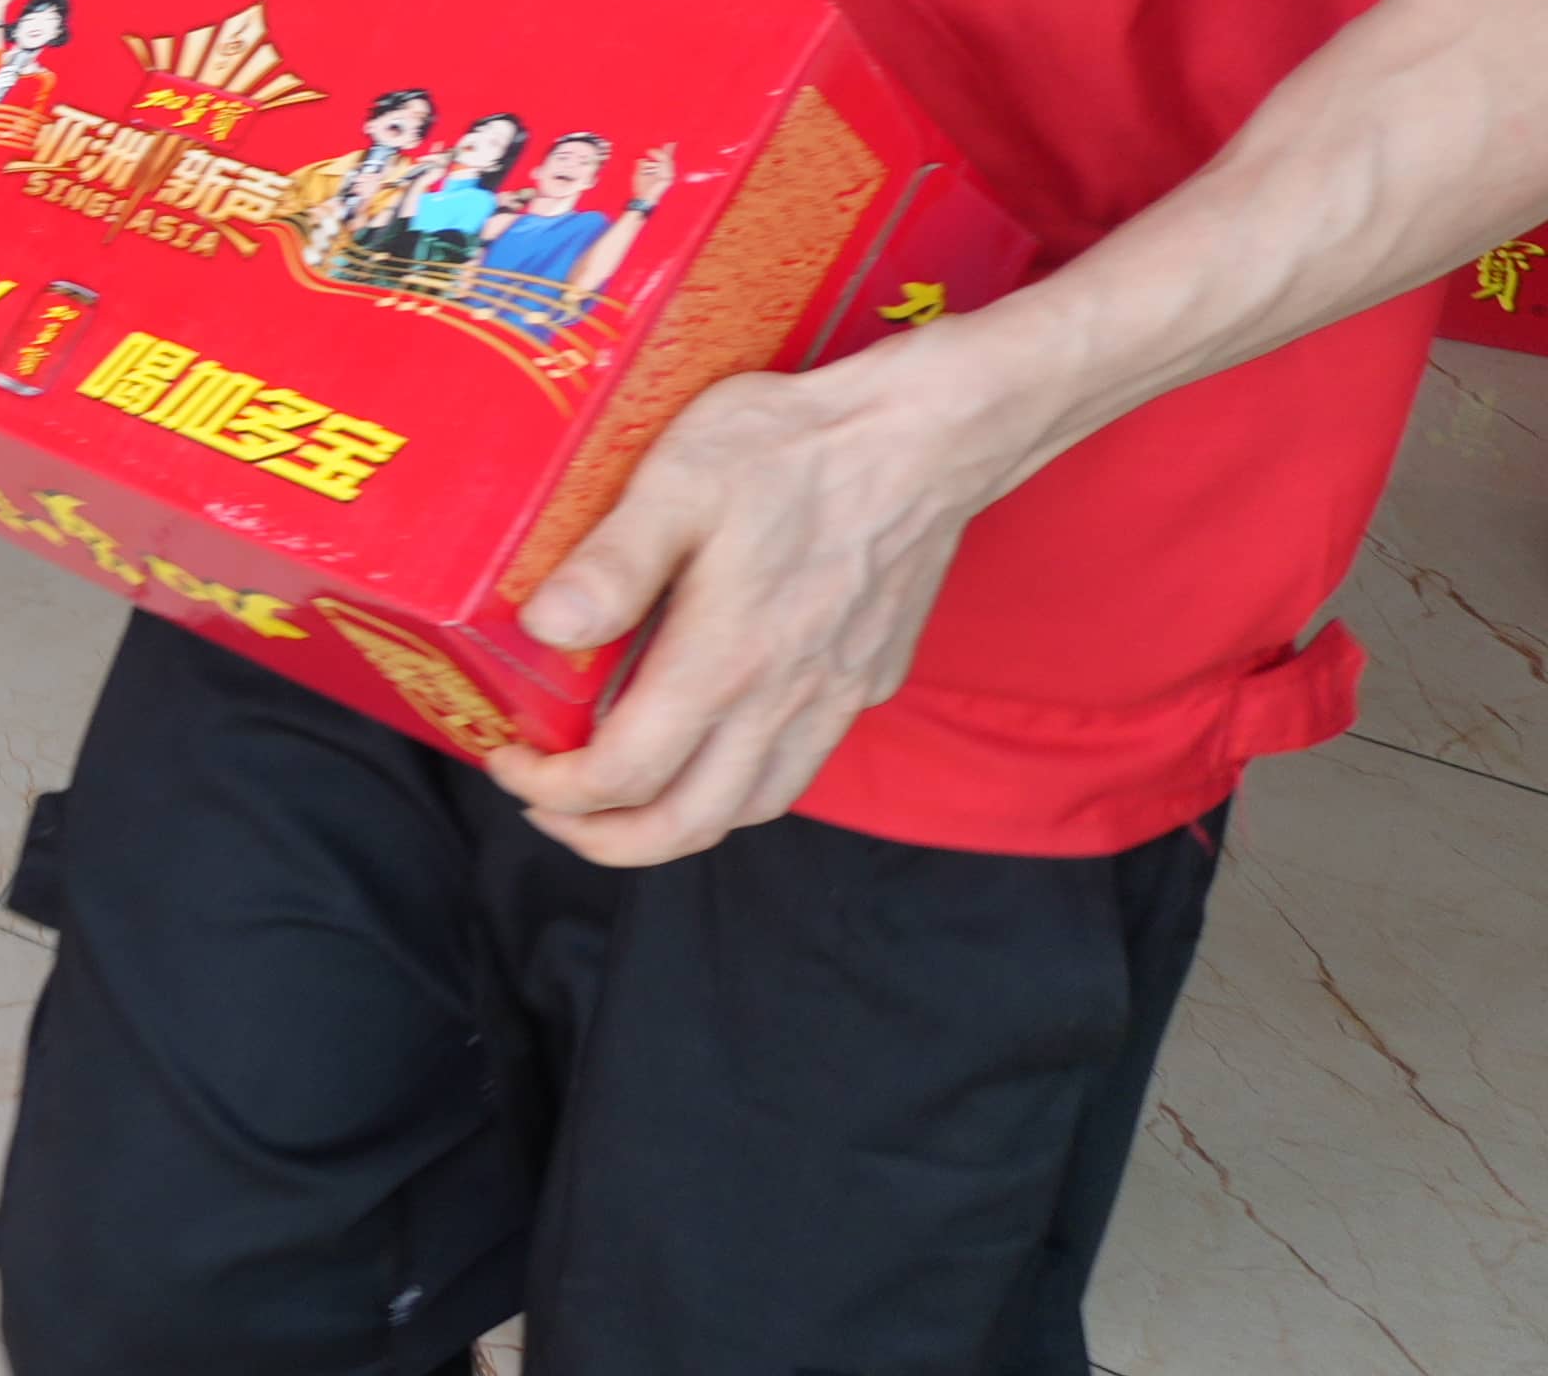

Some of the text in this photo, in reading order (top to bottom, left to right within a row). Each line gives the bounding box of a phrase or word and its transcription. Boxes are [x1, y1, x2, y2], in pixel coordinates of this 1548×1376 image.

[124, 208, 222, 257] ASIA
[75, 330, 411, 503] 喝加多宝
